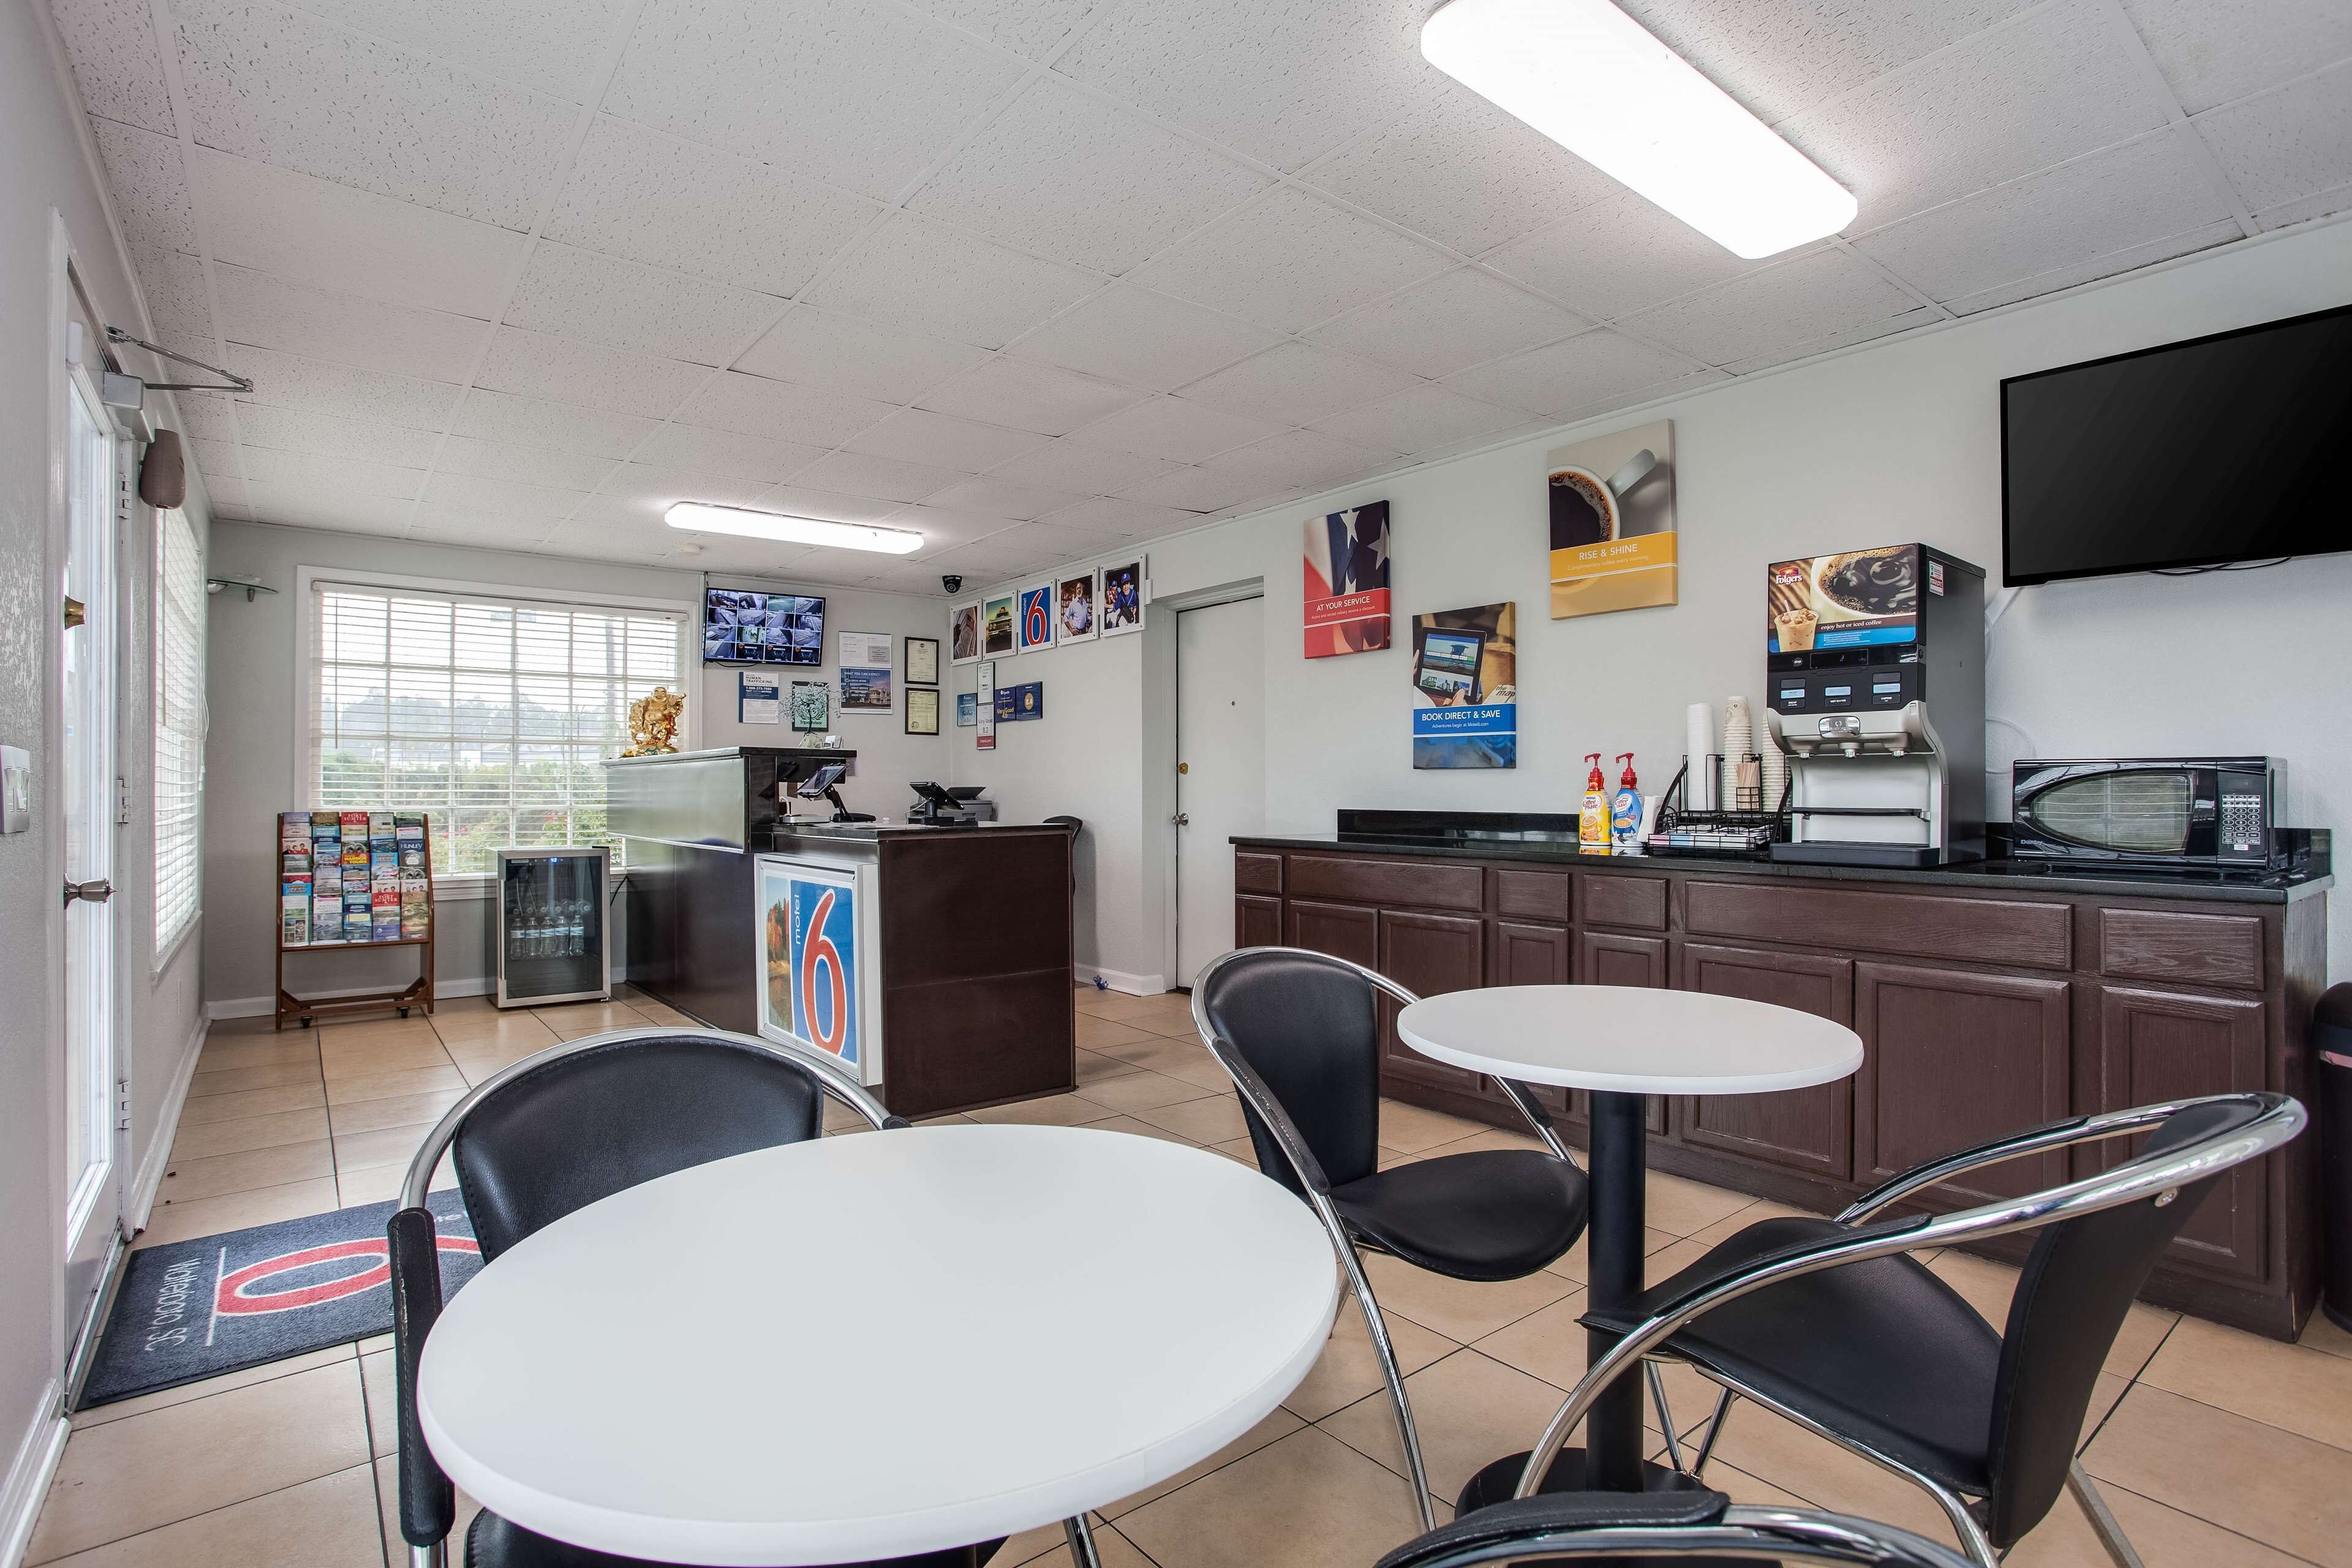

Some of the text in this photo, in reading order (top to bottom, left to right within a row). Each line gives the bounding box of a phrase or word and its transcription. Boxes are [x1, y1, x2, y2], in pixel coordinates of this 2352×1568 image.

[1579, 543, 1638, 560] RISE & SHINE
[1568, 563, 1600, 571] Complimentary
[1776, 575, 1803, 585] Folgers
[1325, 601, 1343, 611] YOUR
[1344, 596, 1370, 607] SERVICE
[1026, 590, 1047, 647] 6
[1496, 690, 1515, 703] map
[1422, 712, 1443, 721] BOOK
[1445, 711, 1471, 720] DIRECT
[1481, 709, 1501, 718] SAVE
[801, 888, 848, 1057] 6
[145, 1257, 202, 1351] Walterboro, SC
